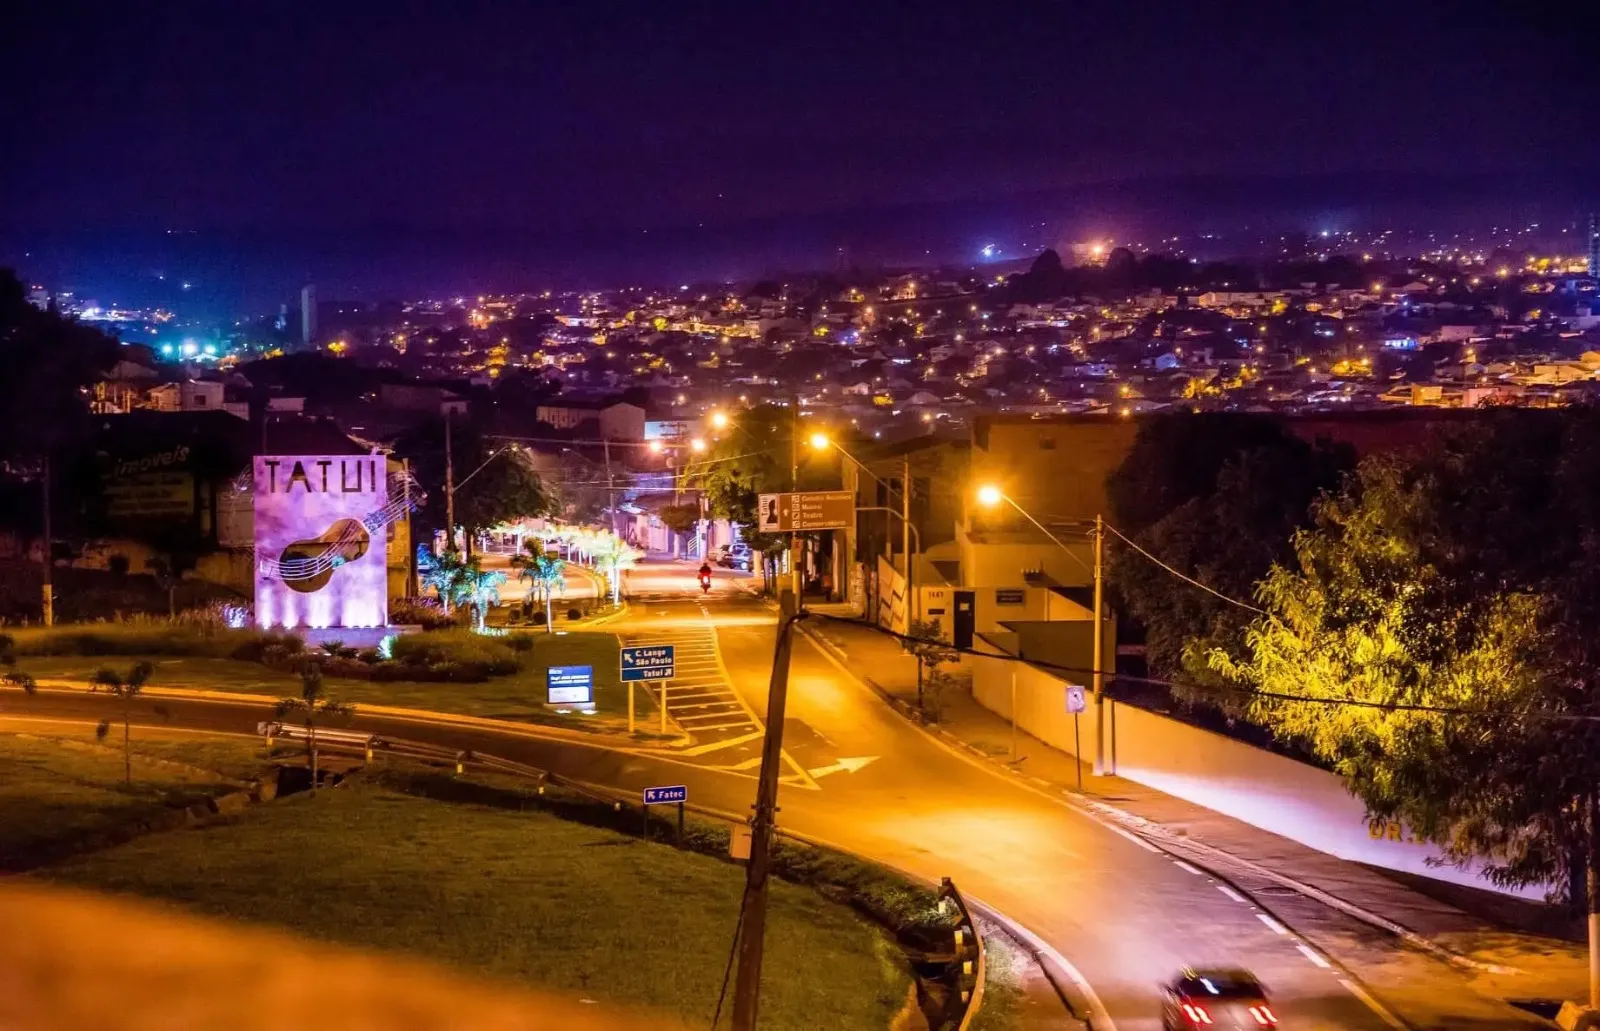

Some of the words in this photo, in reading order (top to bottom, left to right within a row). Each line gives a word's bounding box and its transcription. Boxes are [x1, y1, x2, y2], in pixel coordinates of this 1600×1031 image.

[635, 658, 650, 666] São
[650, 656, 672, 665] Paulo
[658, 790, 684, 799] Fatec
